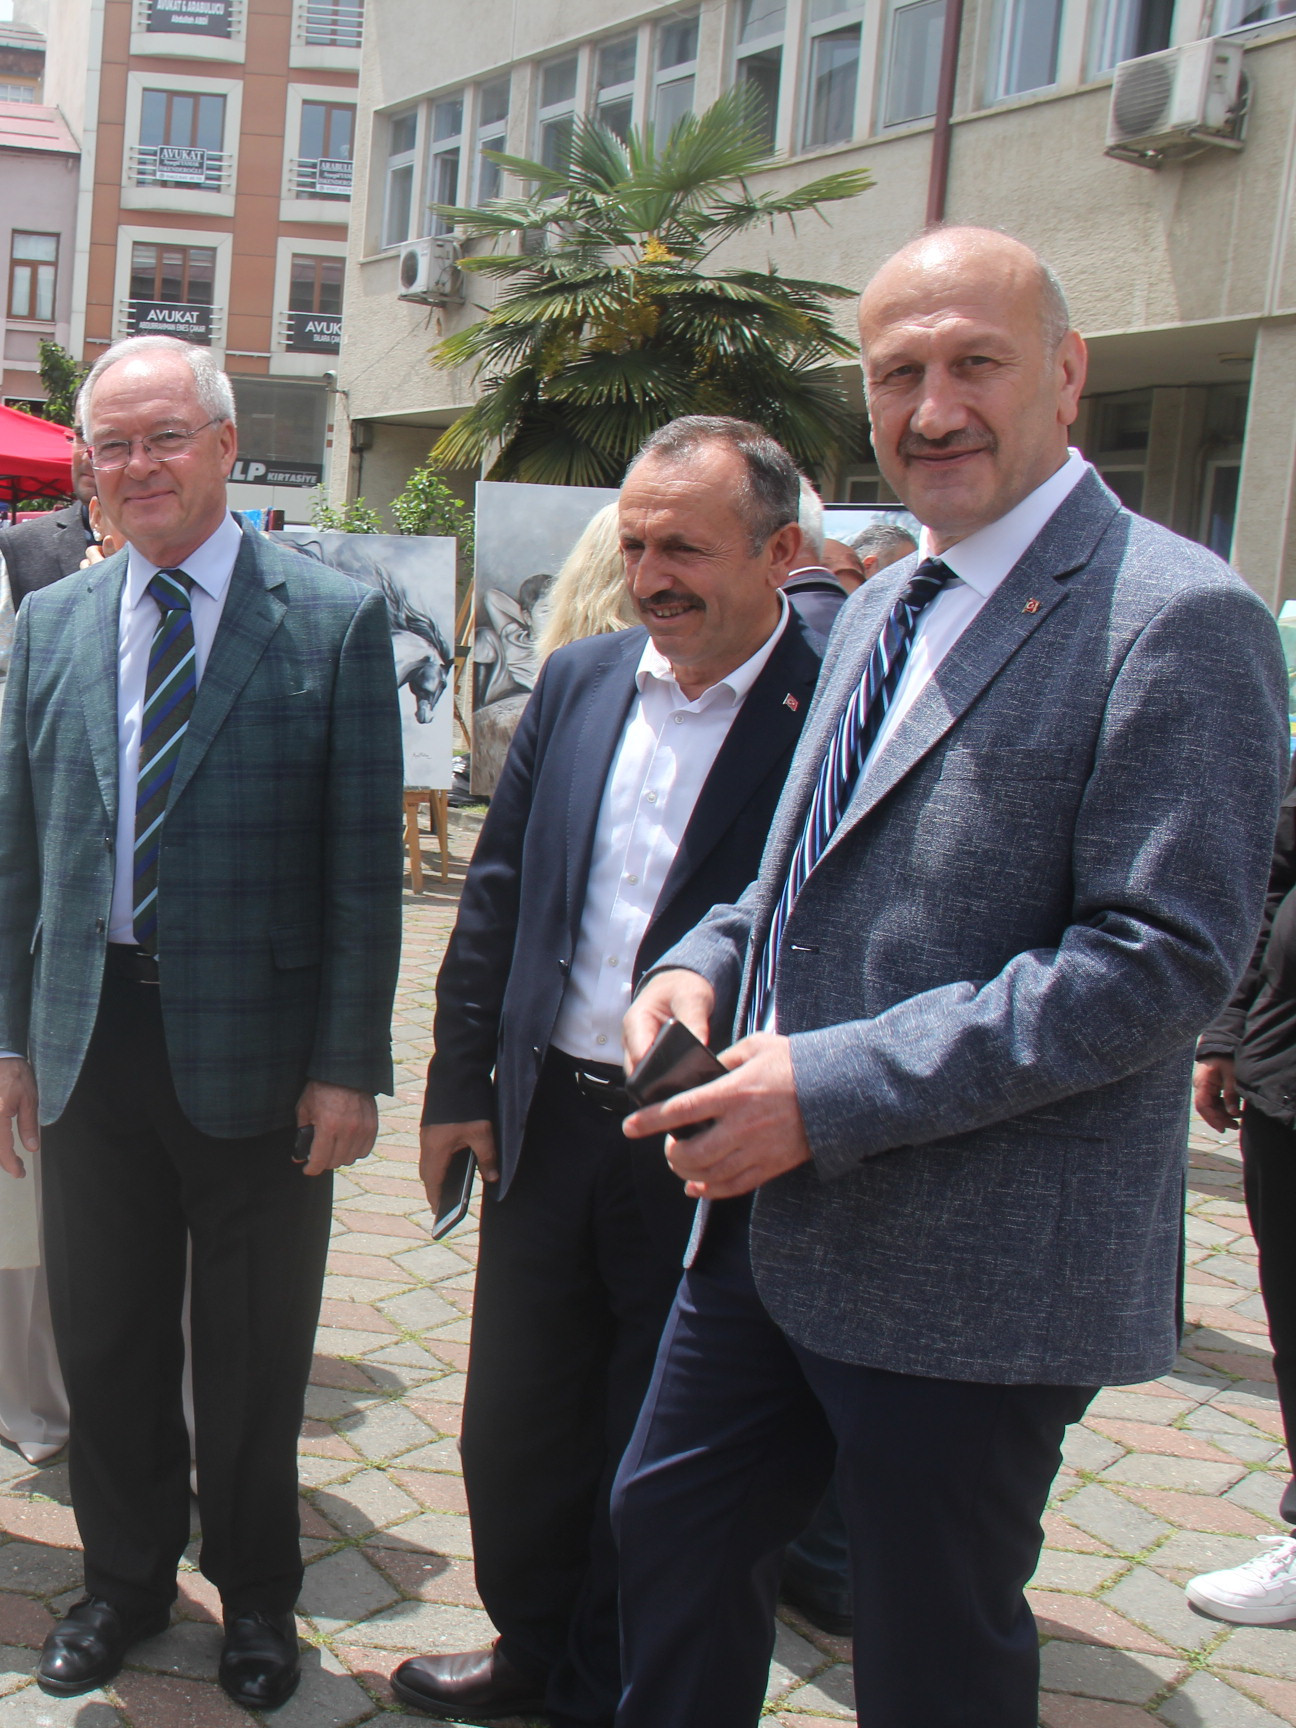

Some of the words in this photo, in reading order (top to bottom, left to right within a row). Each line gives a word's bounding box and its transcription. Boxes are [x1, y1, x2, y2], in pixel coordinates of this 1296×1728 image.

[161, 148, 203, 160] AVUKAT
[146, 309, 200, 323] AVUKAT
[304, 321, 343, 334] AVUK
[227, 461, 266, 481] LP
